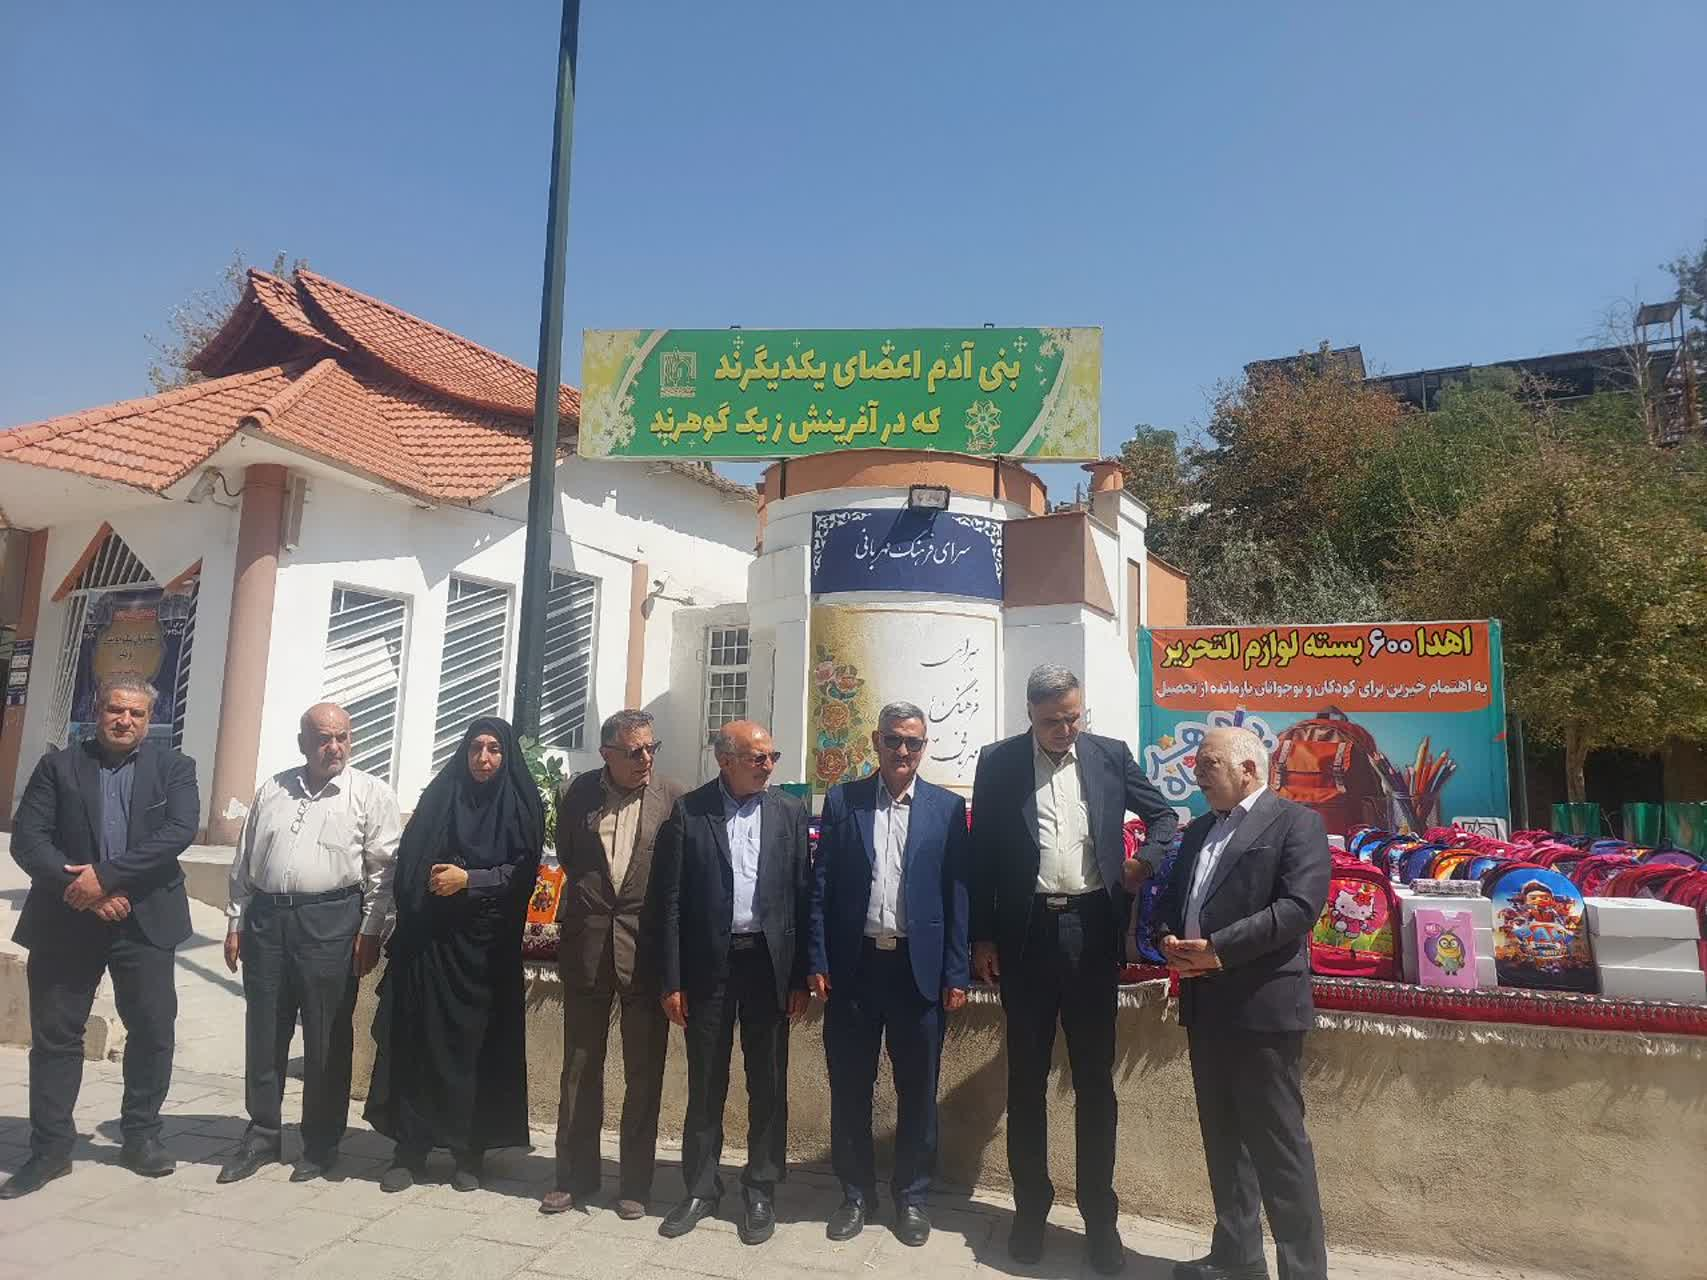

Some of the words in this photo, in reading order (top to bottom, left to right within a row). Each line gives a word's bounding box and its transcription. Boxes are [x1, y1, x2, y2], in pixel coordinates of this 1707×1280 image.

[714, 344, 827, 392] یکدیگرند
[832, 345, 921, 389] اعضای
[927, 340, 975, 394] آدم
[978, 347, 1021, 391] بنی
[650, 401, 731, 443] گوهرند
[788, 400, 879, 444] آفرینش
[880, 412, 906, 444] در
[911, 406, 942, 434] که
[855, 527, 891, 571] مهربانی
[888, 529, 935, 567] فرهنگ
[933, 541, 972, 565] سرای
[1160, 630, 1241, 669] التحریر
[1243, 629, 1299, 671] لوازم
[1302, 632, 1364, 667] بسته
[1368, 628, 1413, 659] ۶۰۰
[1416, 625, 1473, 658] اهدا
[1155, 680, 1198, 699] تحصیل
[1199, 680, 1208, 698] از
[1254, 679, 1304, 698] نوجوانان
[1314, 679, 1356, 699] کودکان
[1358, 680, 1384, 698] برای
[1386, 678, 1427, 699] خیرین
[1428, 678, 1472, 701] اهتمام
